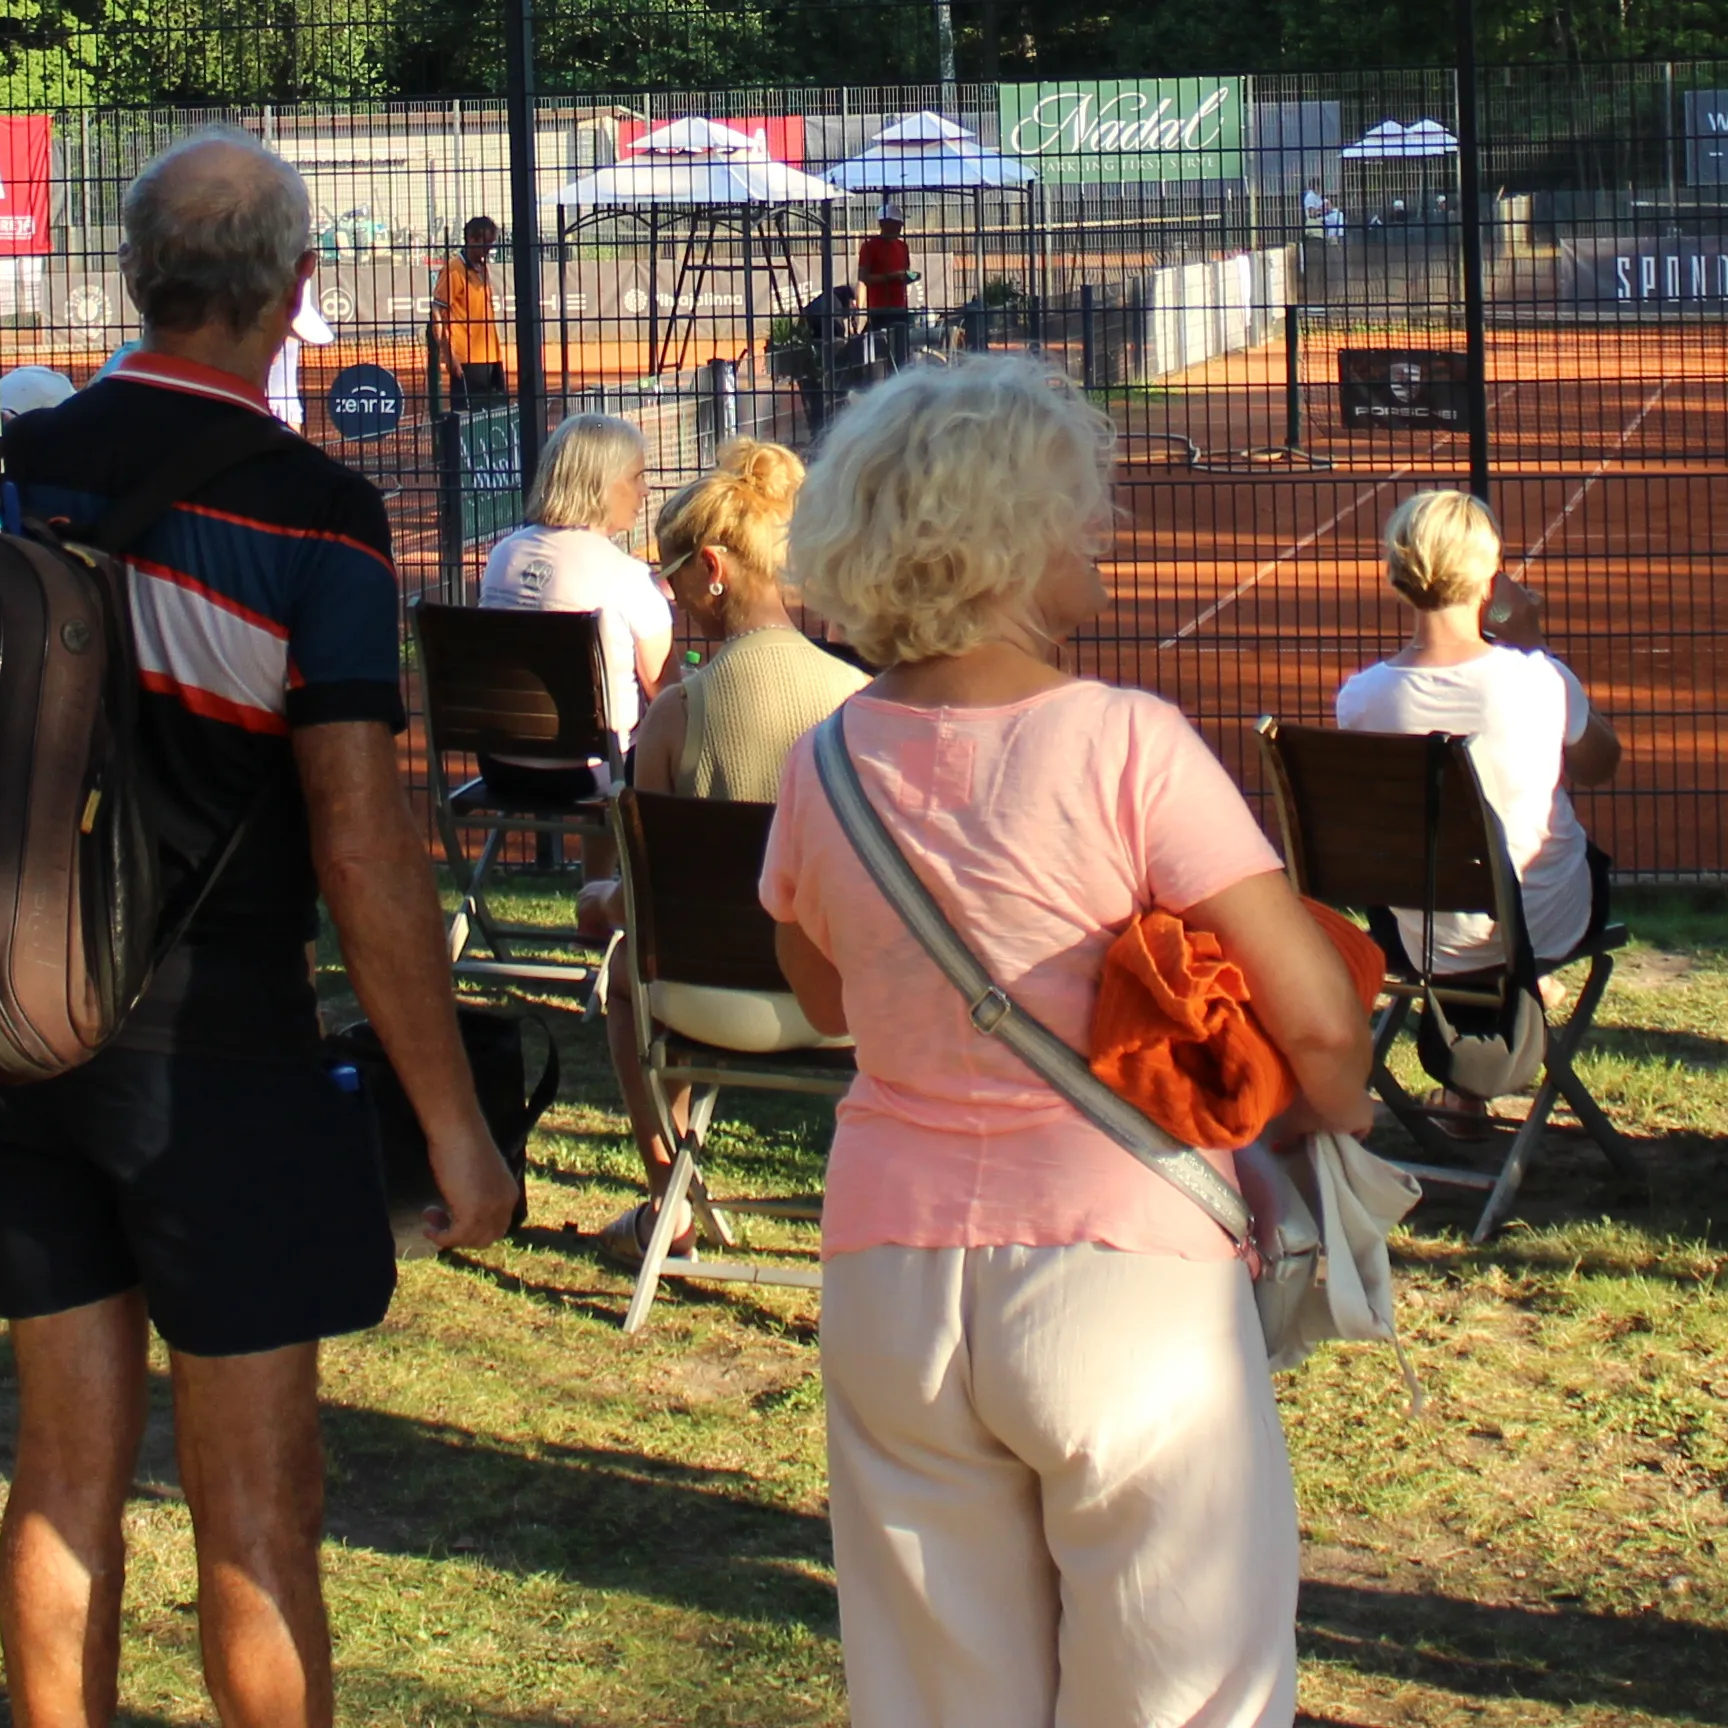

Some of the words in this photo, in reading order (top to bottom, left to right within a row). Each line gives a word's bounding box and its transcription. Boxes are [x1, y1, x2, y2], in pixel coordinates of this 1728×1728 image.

[1010, 86, 1229, 155] Nadal
[1029, 159, 1115, 172] SARKING
[1121, 158, 1161, 170] FIRST
[1168, 156, 1216, 169] SRVE
[655, 292, 743, 311] ihajalinna
[335, 390, 396, 414] zenniz
